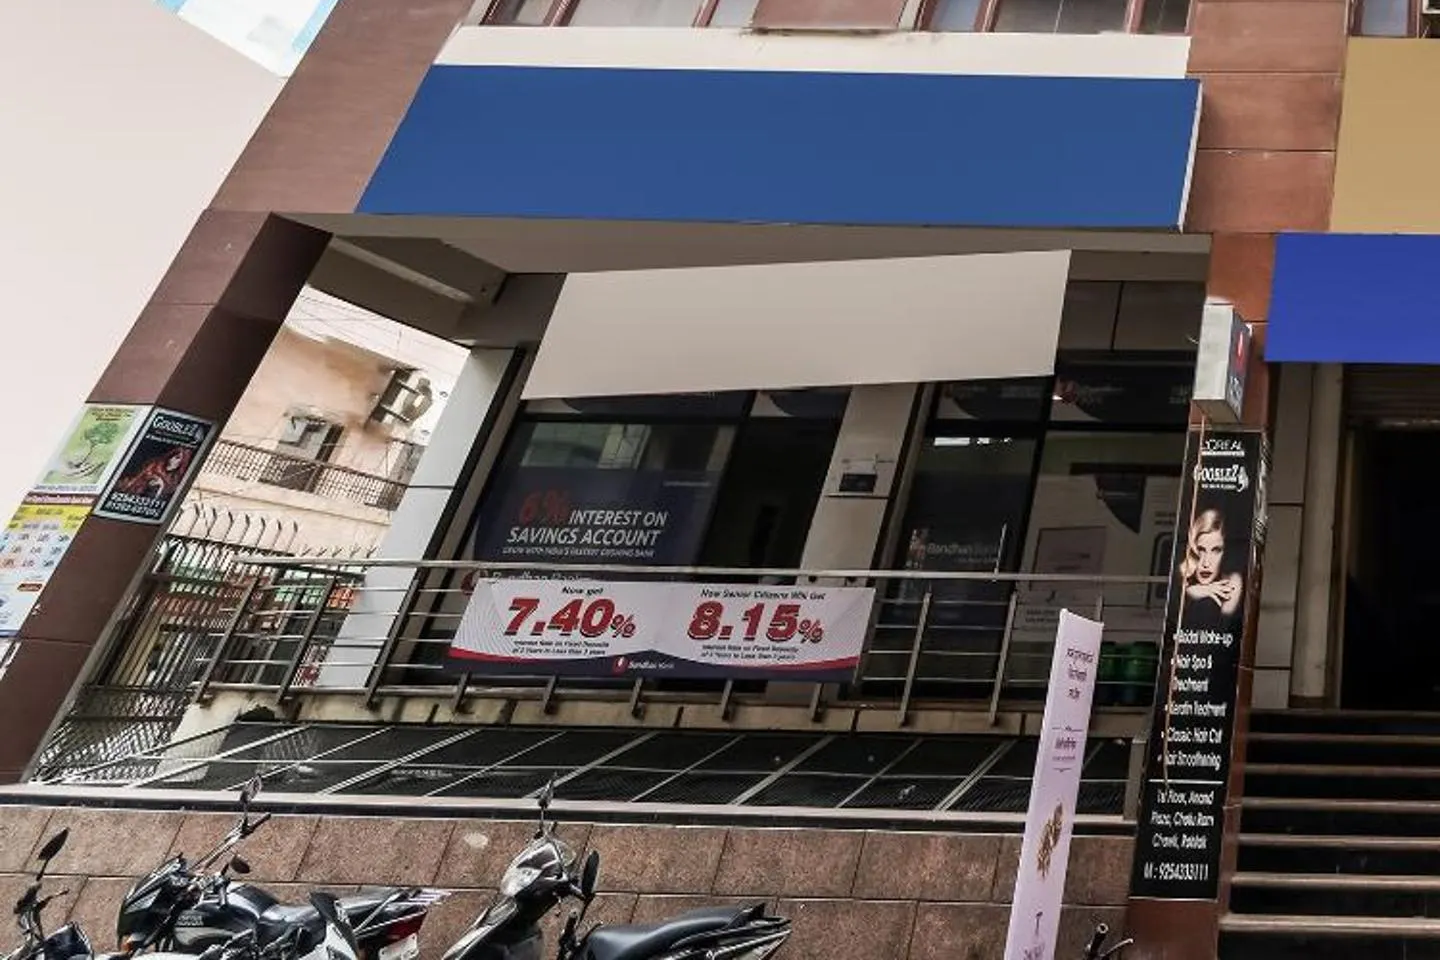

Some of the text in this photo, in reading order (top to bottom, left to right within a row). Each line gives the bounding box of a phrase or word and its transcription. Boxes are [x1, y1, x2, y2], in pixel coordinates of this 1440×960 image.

[568, 510, 642, 526] INTEREST
[643, 511, 668, 528] ON
[506, 527, 661, 546] SAVINGS ACCOUNT
[562, 587, 604, 596] Now get
[504, 597, 636, 638] 7.40%
[687, 601, 824, 643] 8.15%
[1199, 630, 1233, 647] Make-up
[1194, 701, 1227, 717] Treatment
[1188, 791, 1214, 805] Anand
